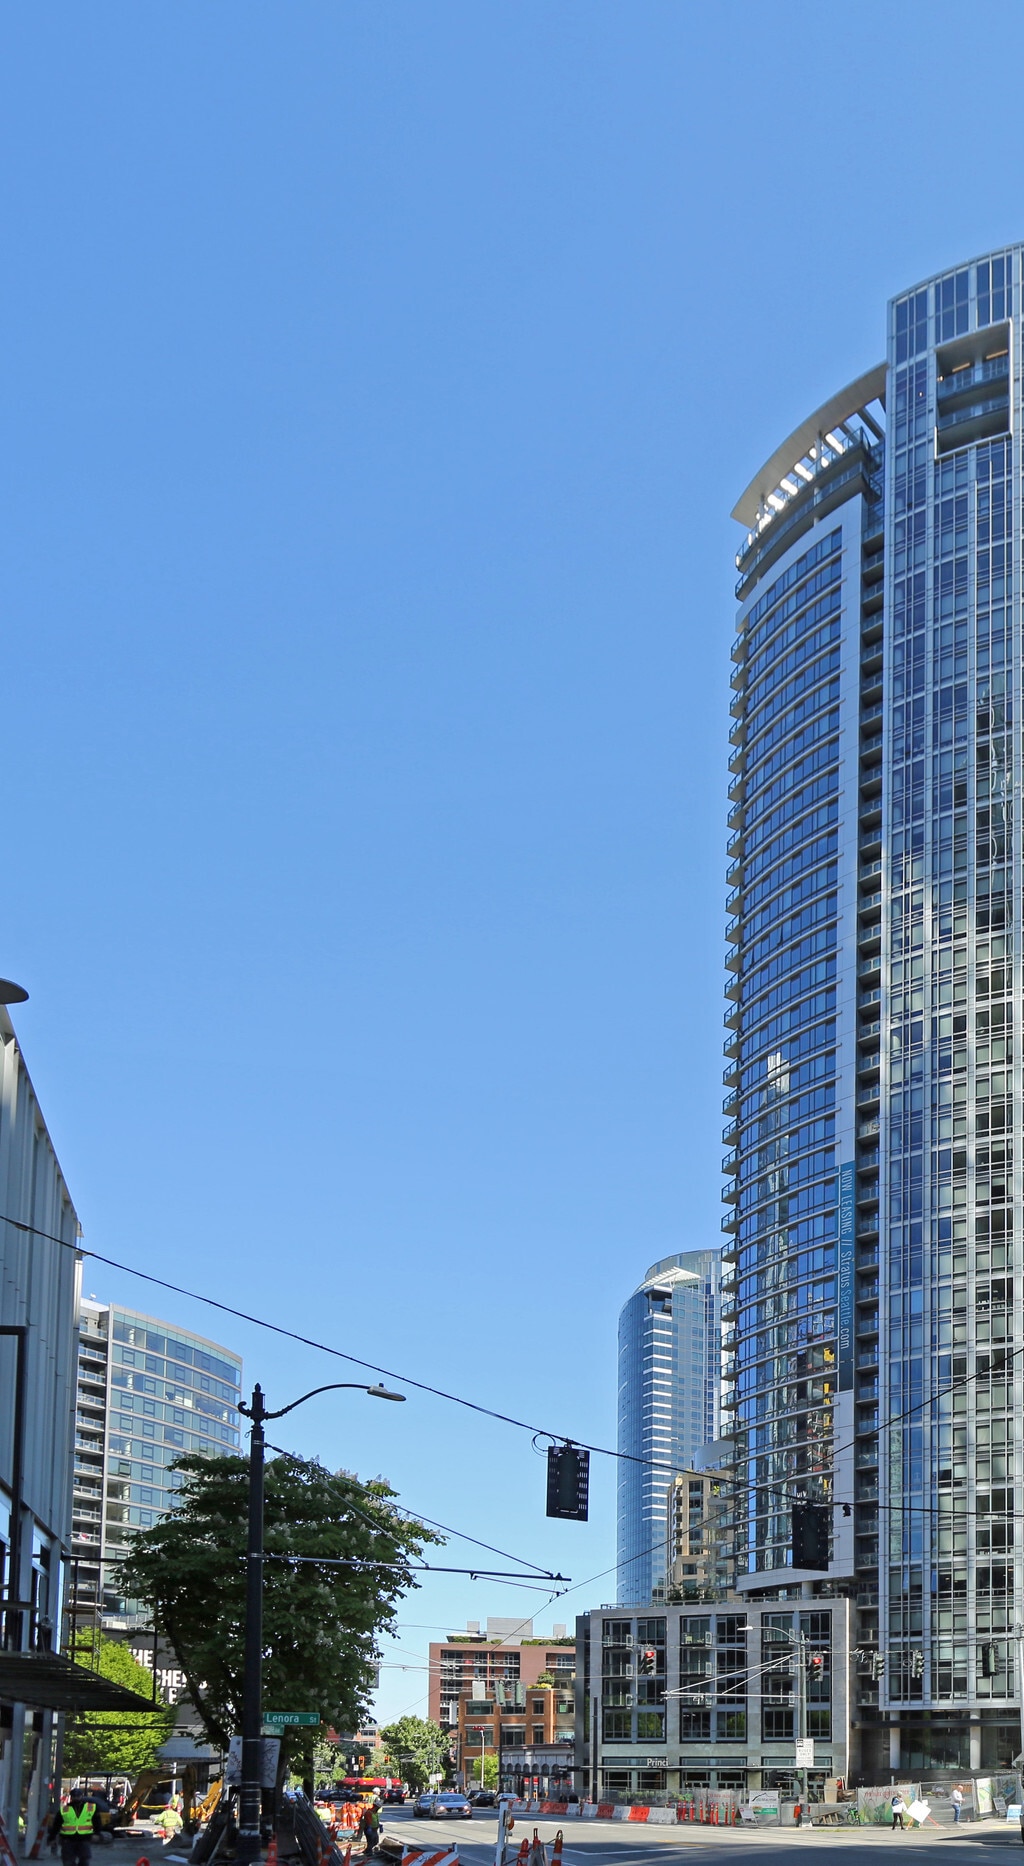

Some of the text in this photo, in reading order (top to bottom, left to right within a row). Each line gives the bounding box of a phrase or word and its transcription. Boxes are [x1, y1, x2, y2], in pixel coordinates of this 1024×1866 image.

[841, 1169, 853, 1192] NOW
[841, 1194, 853, 1235] LEASING
[266, 1714, 299, 1722] Lenora
[647, 1757, 669, 1767] Princi
